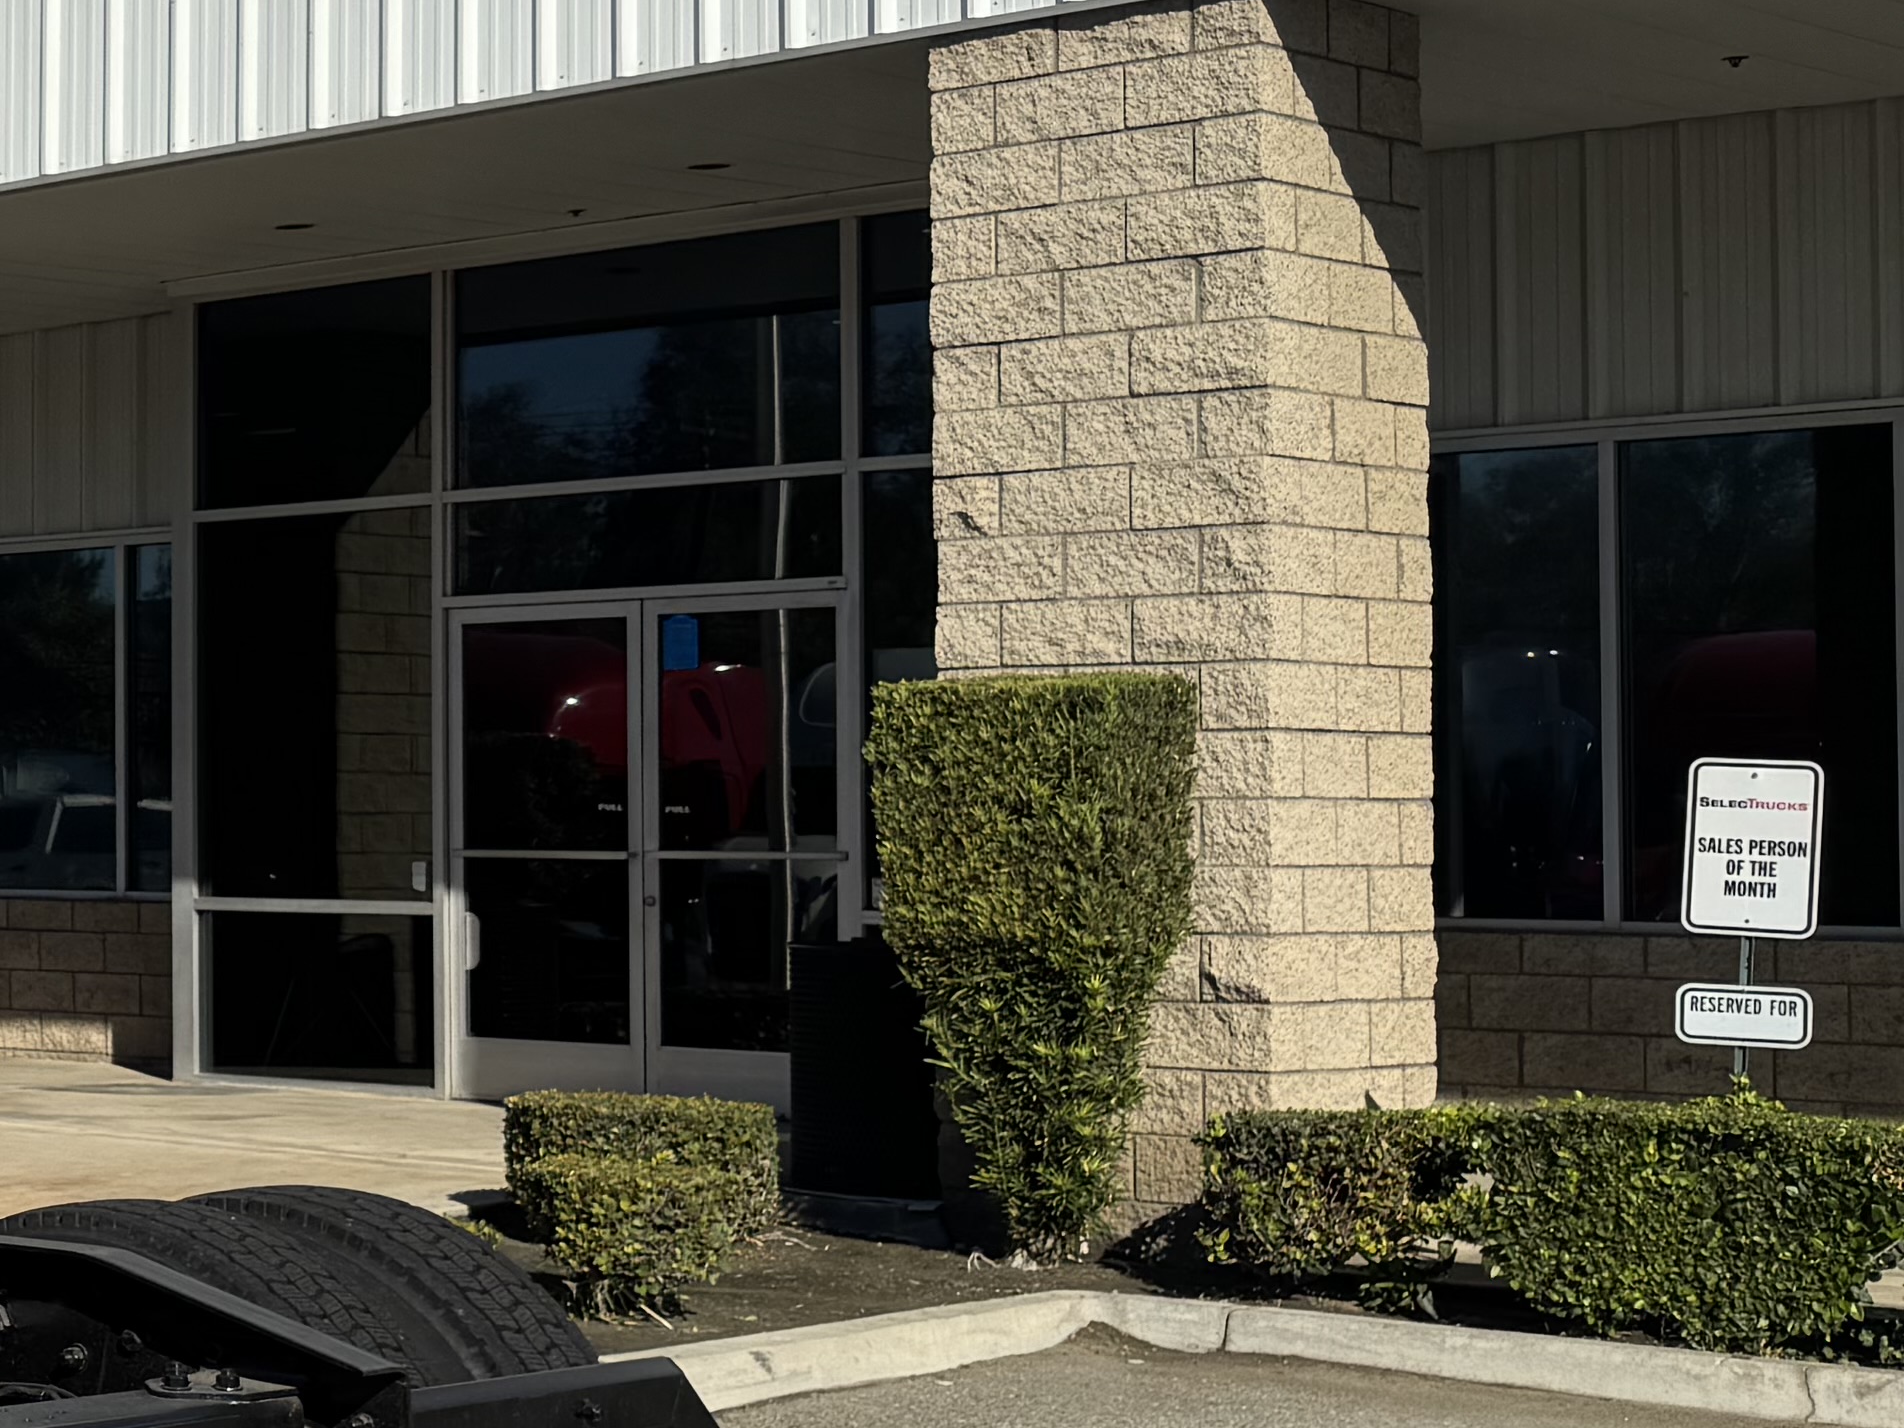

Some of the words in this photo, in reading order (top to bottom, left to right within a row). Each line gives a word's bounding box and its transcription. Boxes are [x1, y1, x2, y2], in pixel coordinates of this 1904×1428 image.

[1698, 837, 1743, 856] SALES
[1749, 839, 1808, 858] PERSON
[1725, 859, 1744, 876] OF
[1749, 860, 1777, 878] THE
[1723, 880, 1777, 899] MONTH
[1690, 995, 1762, 1015] RESERVED
[1769, 998, 1798, 1017] FOR
